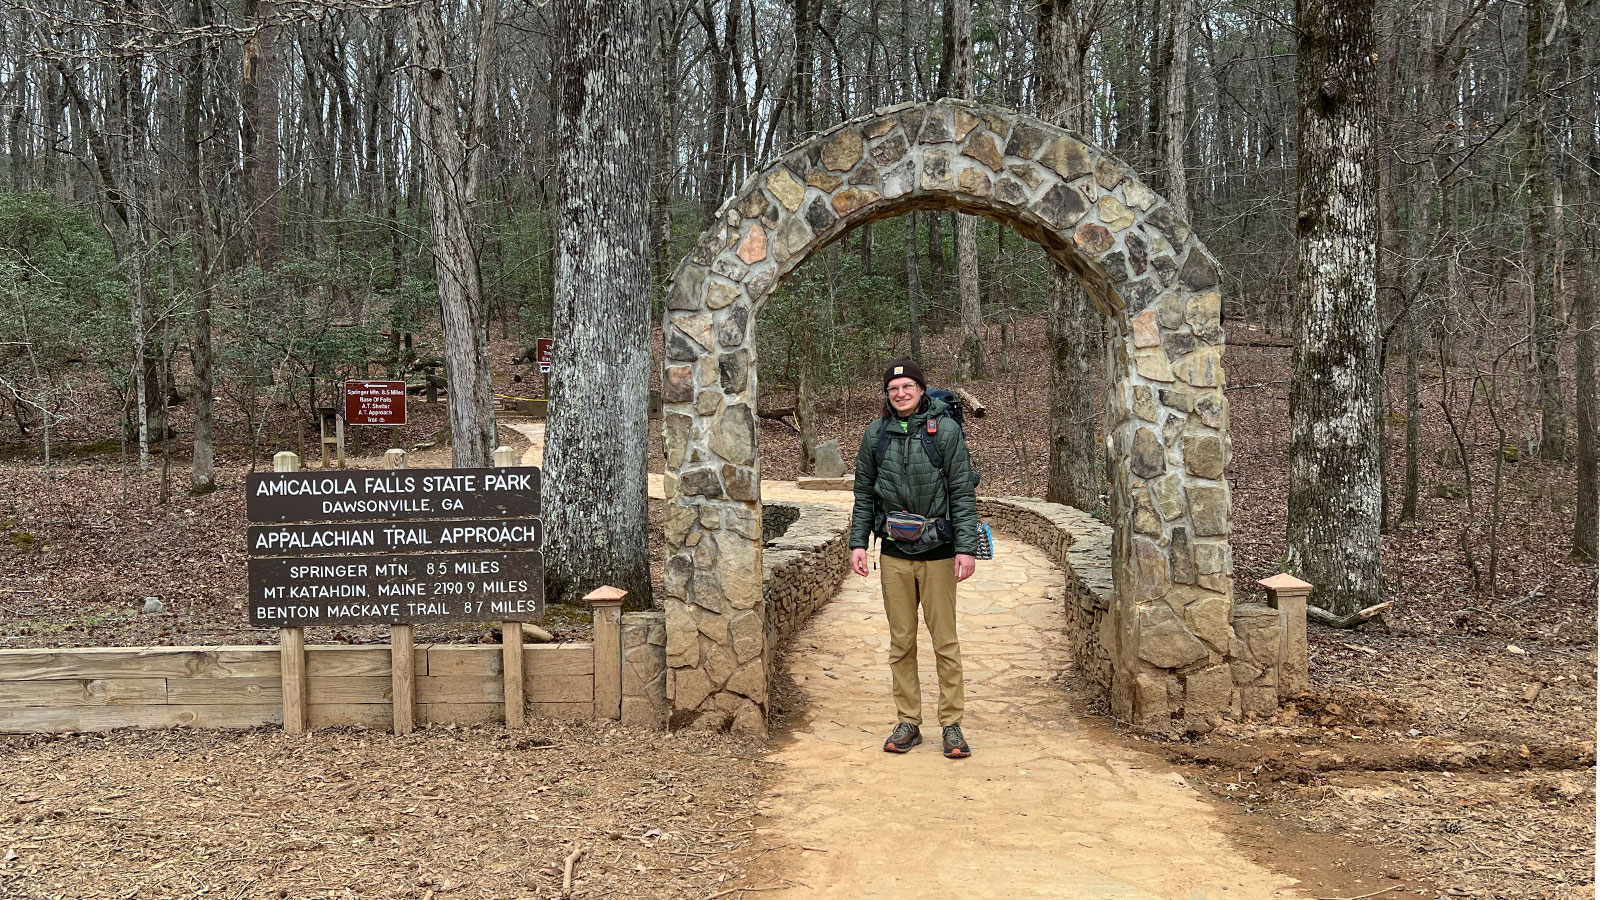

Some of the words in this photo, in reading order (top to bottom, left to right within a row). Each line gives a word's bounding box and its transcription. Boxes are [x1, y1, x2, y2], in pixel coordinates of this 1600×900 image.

[256, 479, 357, 496] AMICALOLA
[365, 476, 415, 494] FALLS
[422, 475, 476, 493] STATE
[484, 473, 531, 491] PARK
[322, 498, 434, 514] DAWSONVILLE,
[441, 498, 464, 511] GA
[255, 529, 374, 549] APPALACHIAN
[383, 528, 432, 545] TRAIL
[439, 525, 535, 544] APPROACH
[290, 564, 368, 579] SPRINGER
[454, 561, 500, 575] MILES
[378, 583, 426, 597] MAINE
[483, 580, 528, 594] MILES
[257, 605, 319, 619] BENTON
[327, 603, 400, 618] MACKAYE
[407, 602, 450, 616] TRAIL
[491, 600, 536, 614] MILES
